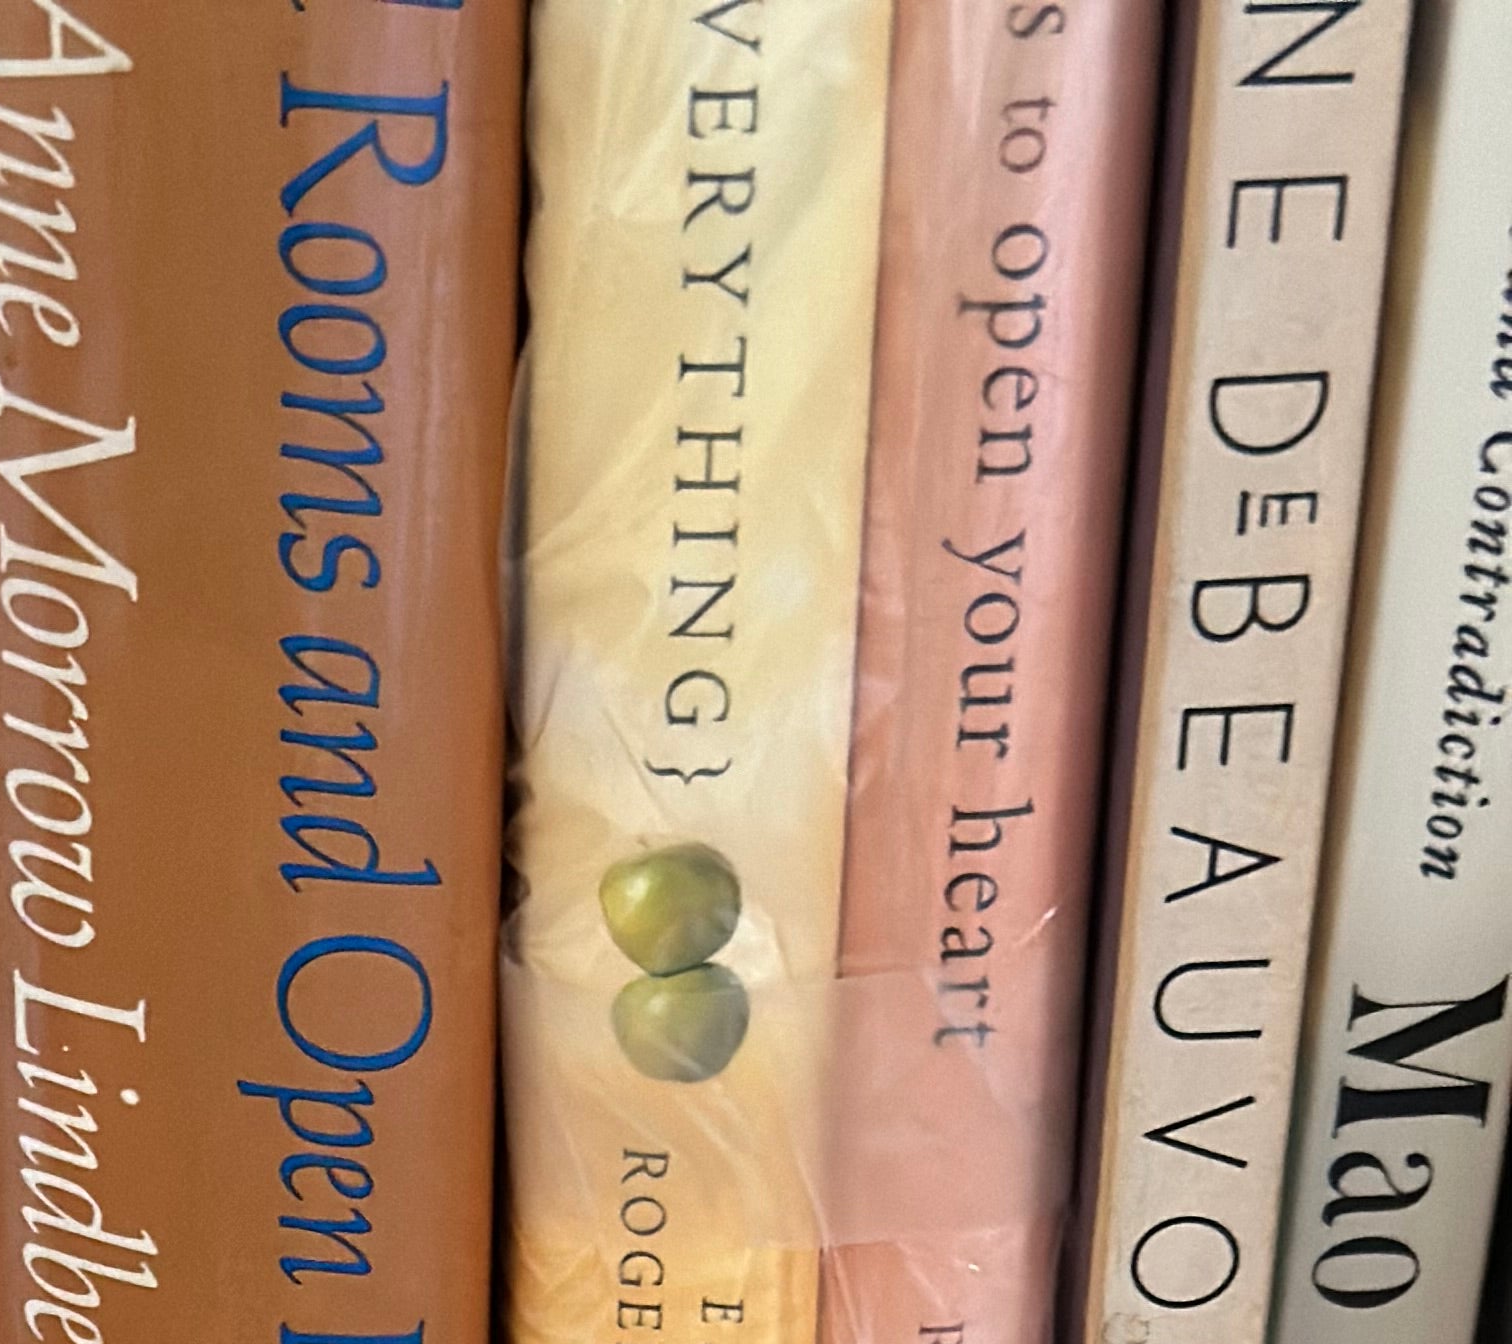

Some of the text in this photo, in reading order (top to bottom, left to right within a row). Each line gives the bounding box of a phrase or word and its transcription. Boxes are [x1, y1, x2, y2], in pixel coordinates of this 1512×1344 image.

[998, 96, 1057, 174] to
[277, 70, 450, 593] Rooms
[956, 223, 1049, 484] open
[277, 634, 443, 893] and
[941, 527, 1026, 759] your
[932, 796, 1035, 1050] heart
[236, 934, 434, 1286] Open
[1311, 973, 1509, 1309] Mao
